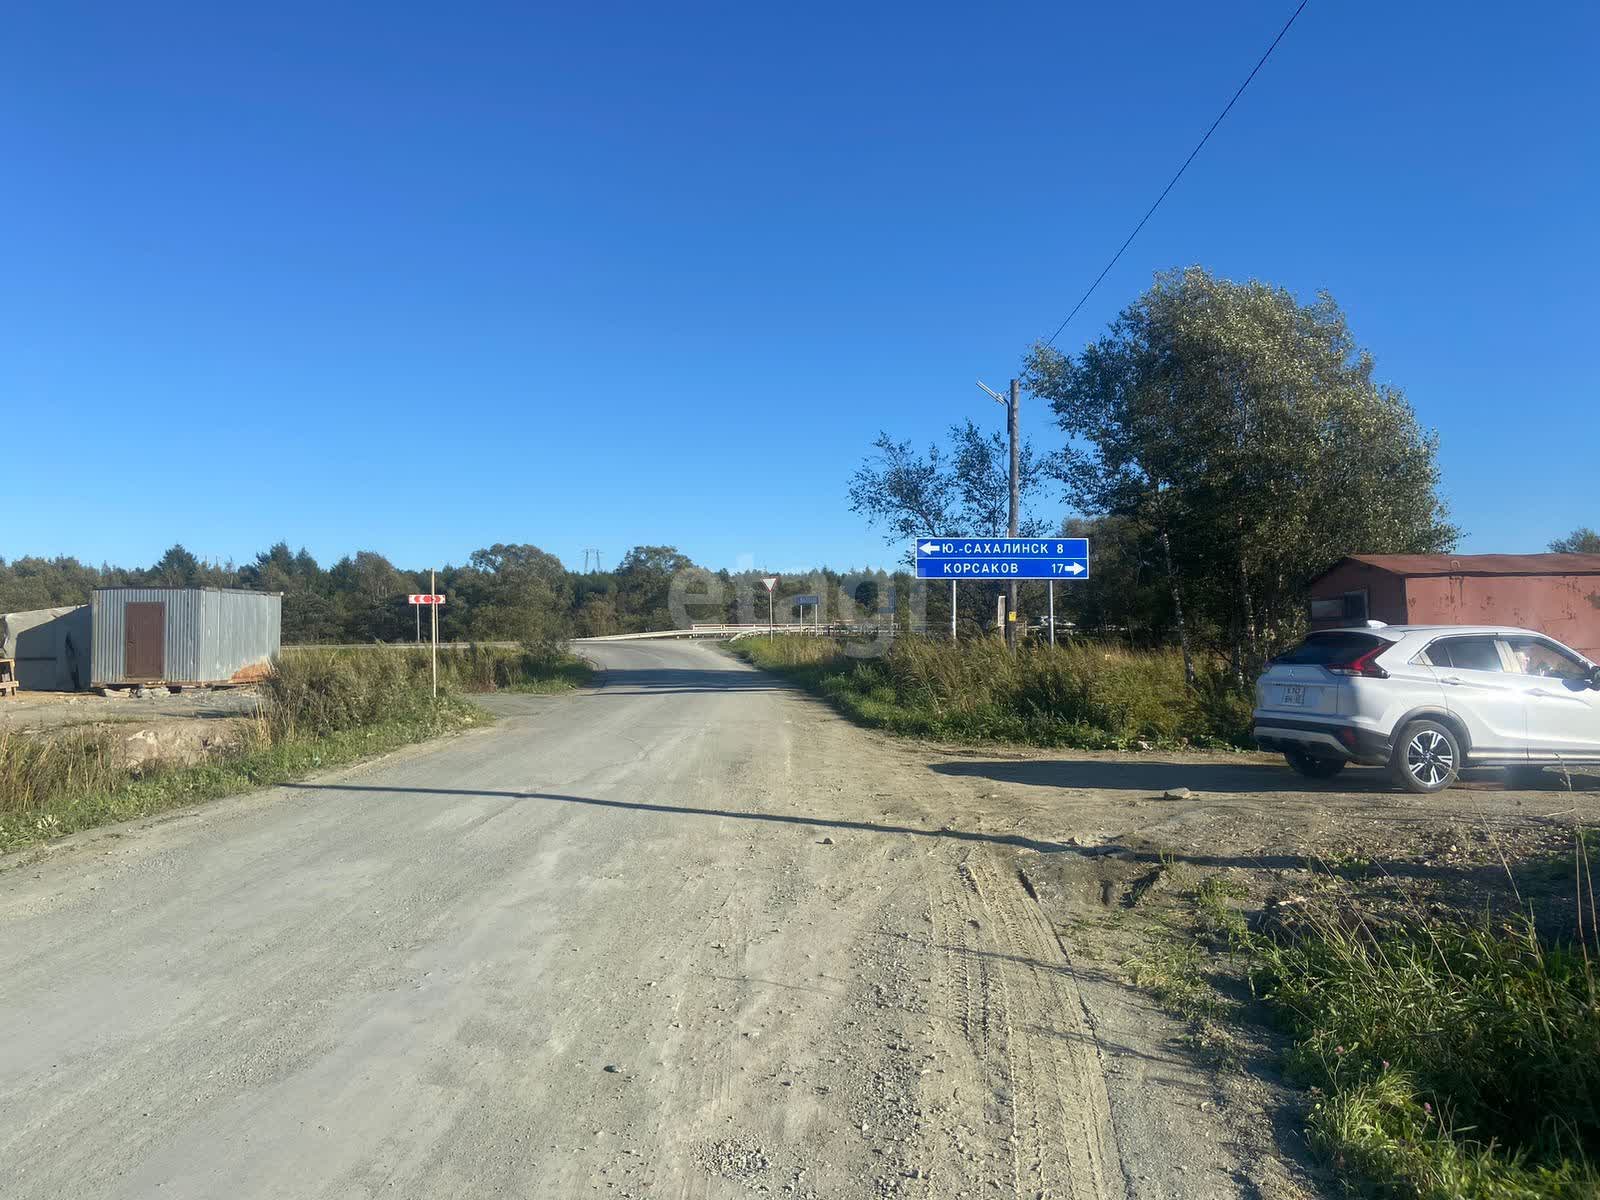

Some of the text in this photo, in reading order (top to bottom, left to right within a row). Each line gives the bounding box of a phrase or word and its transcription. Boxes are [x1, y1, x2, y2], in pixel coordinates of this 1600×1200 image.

[942, 543, 1064, 554] Ю.-САХАЛИНСК 8
[943, 563, 1064, 573] КОРСАКОВ 17
